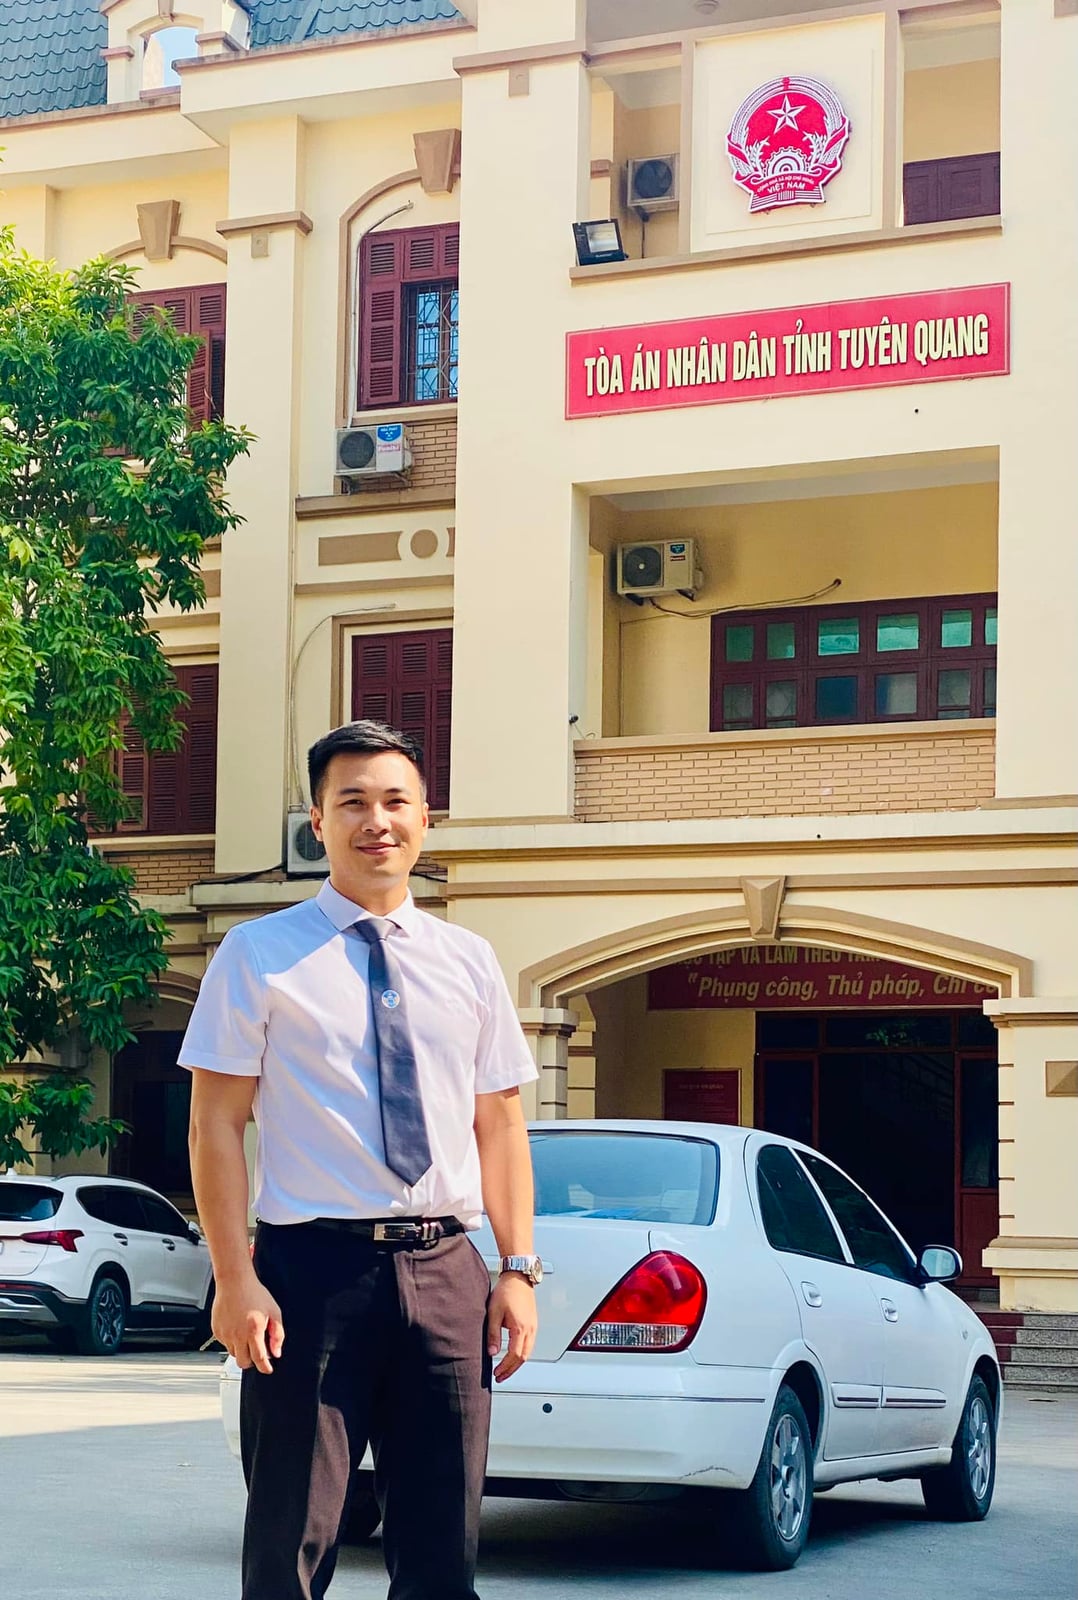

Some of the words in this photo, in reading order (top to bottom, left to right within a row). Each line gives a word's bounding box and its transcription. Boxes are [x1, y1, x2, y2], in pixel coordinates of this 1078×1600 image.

[767, 182, 785, 193] VIỆT
[786, 181, 805, 190] NAM
[584, 347, 624, 397] TÒA
[630, 343, 660, 392] ÁN
[667, 336, 727, 388] NHÂN
[732, 331, 776, 381] DÂN
[783, 319, 832, 376] TỈNH
[838, 316, 907, 370] TUYÊN
[914, 313, 988, 366] QUANG
[765, 975, 818, 1001] công,
[828, 971, 863, 996] Thủ
[868, 973, 925, 1000] pháp,
